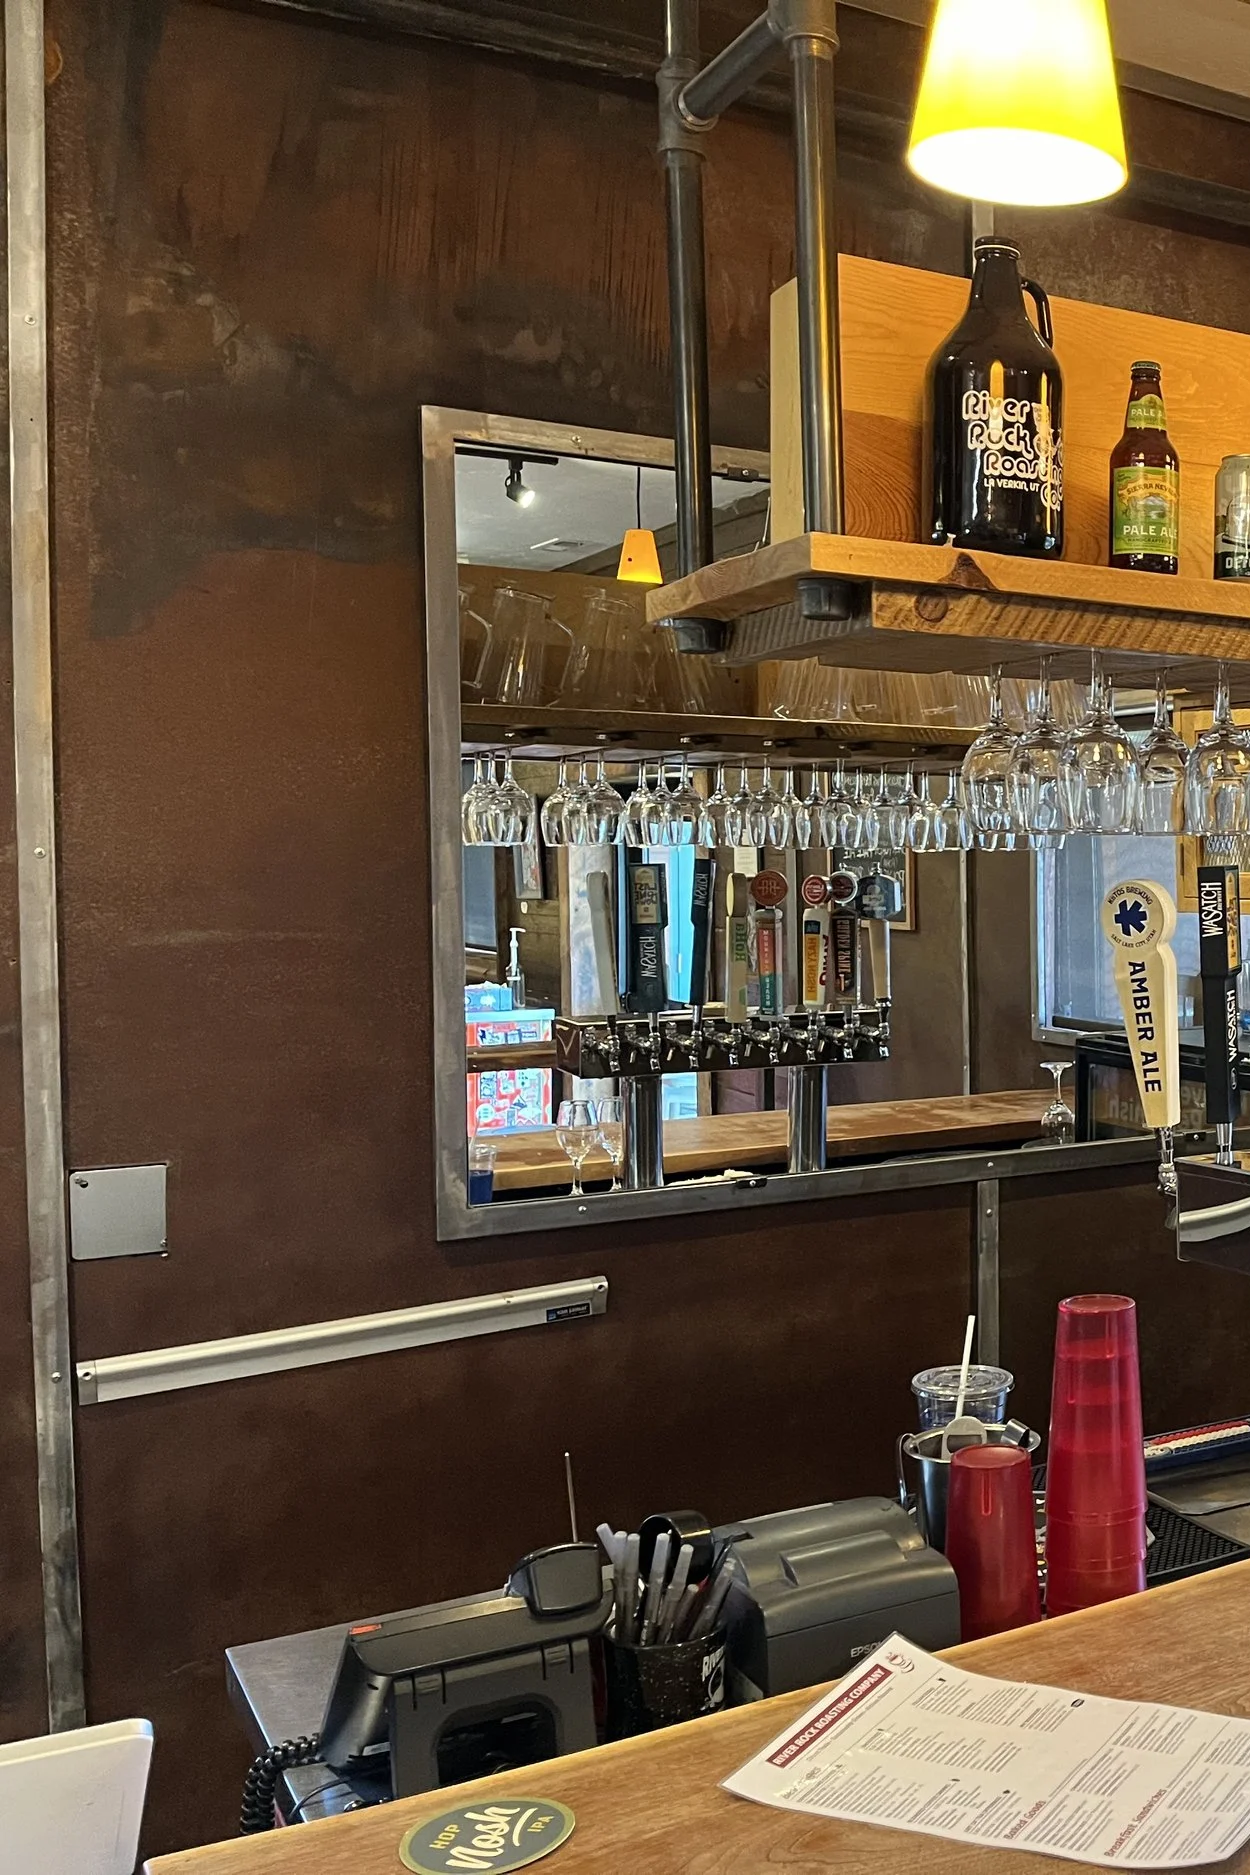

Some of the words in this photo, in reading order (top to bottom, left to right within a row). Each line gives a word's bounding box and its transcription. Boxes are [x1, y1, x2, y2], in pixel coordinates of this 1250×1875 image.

[962, 390, 1031, 423] River
[1131, 407, 1156, 417] PALE
[967, 421, 1034, 460] Rock
[1030, 481, 1041, 492] UT
[1123, 525, 1157, 537] PALE
[1160, 527, 1178, 539] ALE
[1201, 882, 1224, 938] WASATCH
[1128, 961, 1156, 1041] AMBER
[1226, 989, 1239, 1063] WASATCH
[1140, 1051, 1162, 1093] ALE
[773, 1744, 800, 1767] RIVER
[797, 1726, 818, 1747] ROCK
[815, 1696, 853, 1731] ROASTING
[849, 1668, 886, 1699] COMPANY
[428, 1823, 461, 1850] HOP
[526, 1815, 555, 1833] IPA
[1104, 1823, 1138, 1858] Breakfast
